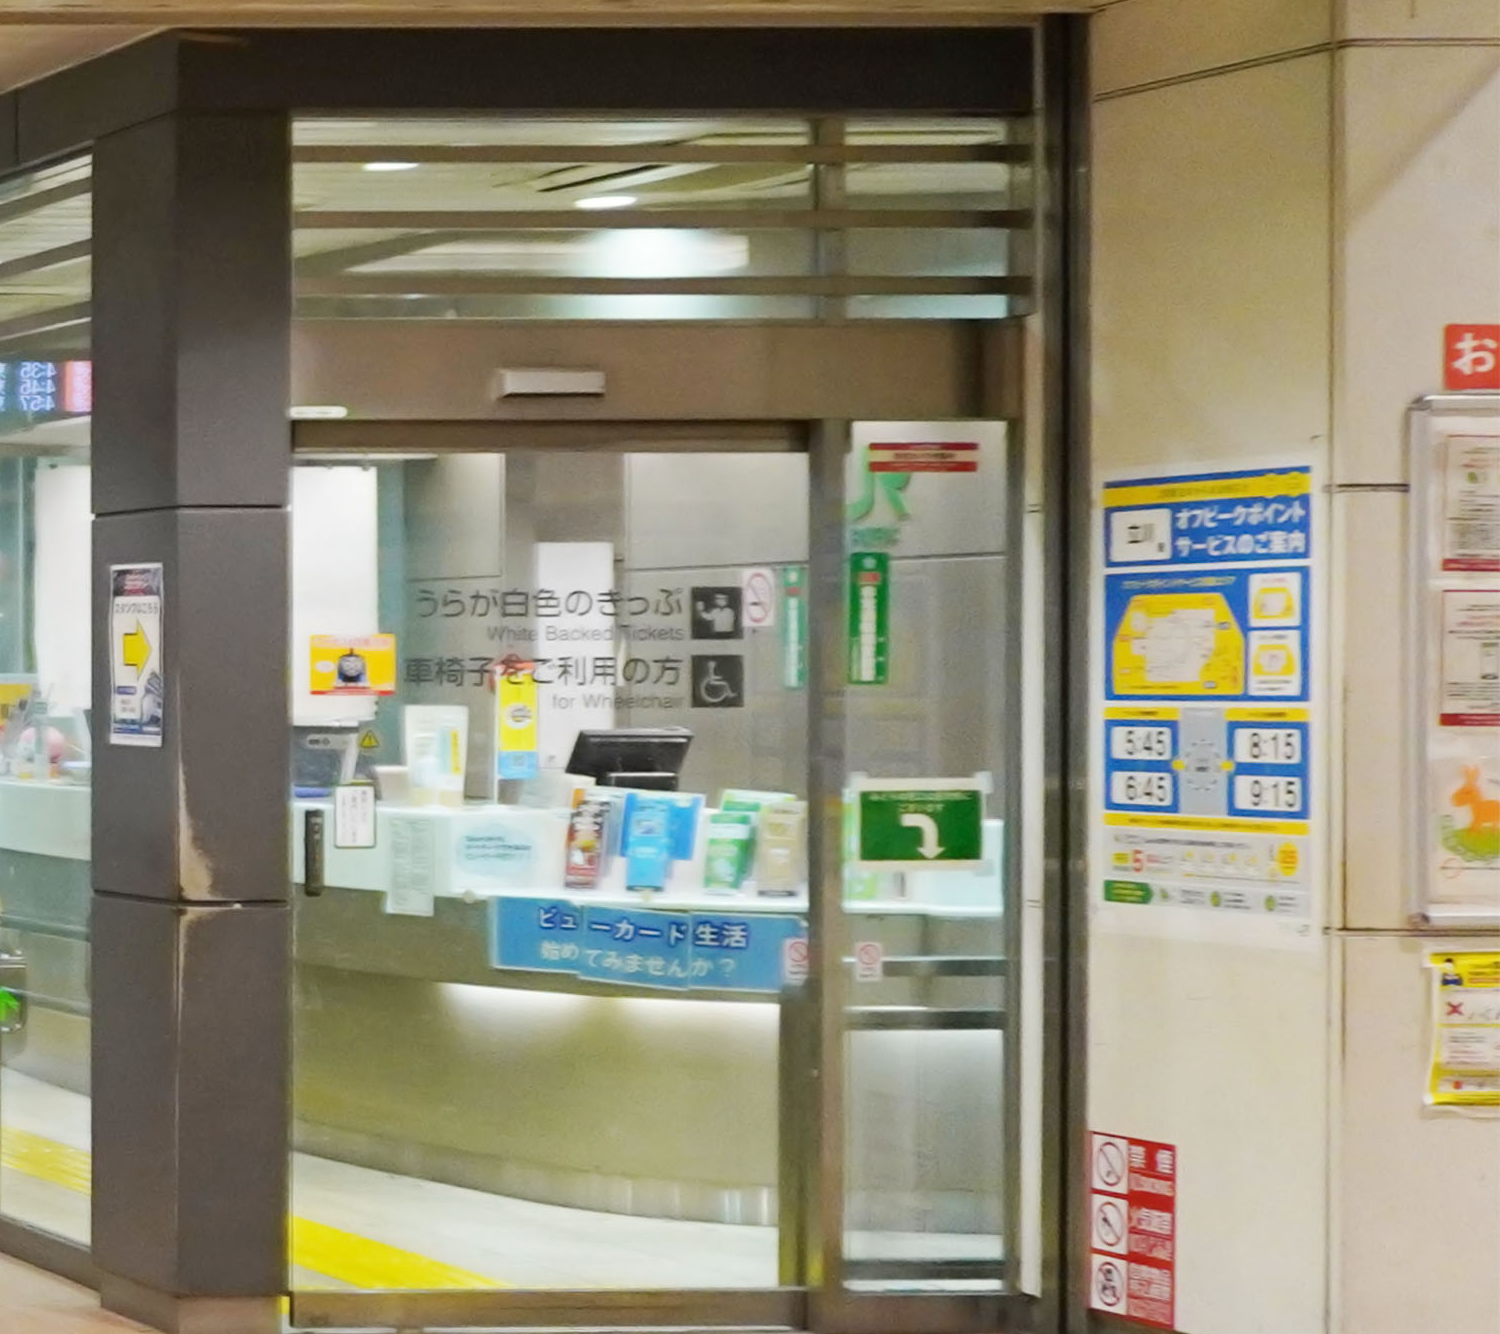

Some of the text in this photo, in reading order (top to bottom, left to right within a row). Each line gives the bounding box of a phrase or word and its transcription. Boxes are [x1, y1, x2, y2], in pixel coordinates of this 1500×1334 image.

[1175, 505, 1305, 529] オフピークポイント
[1175, 532, 1305, 556] サービスのご案内
[416, 588, 683, 618] うらが白色のきっぷ
[487, 625, 685, 641] White Backed Tickets
[404, 654, 684, 687] 車椅子をご利用の方
[552, 694, 685, 708] for Wheelchair
[1124, 729, 1296, 760] 5:45 8:15
[1125, 775, 1297, 808] 6:45 9:15
